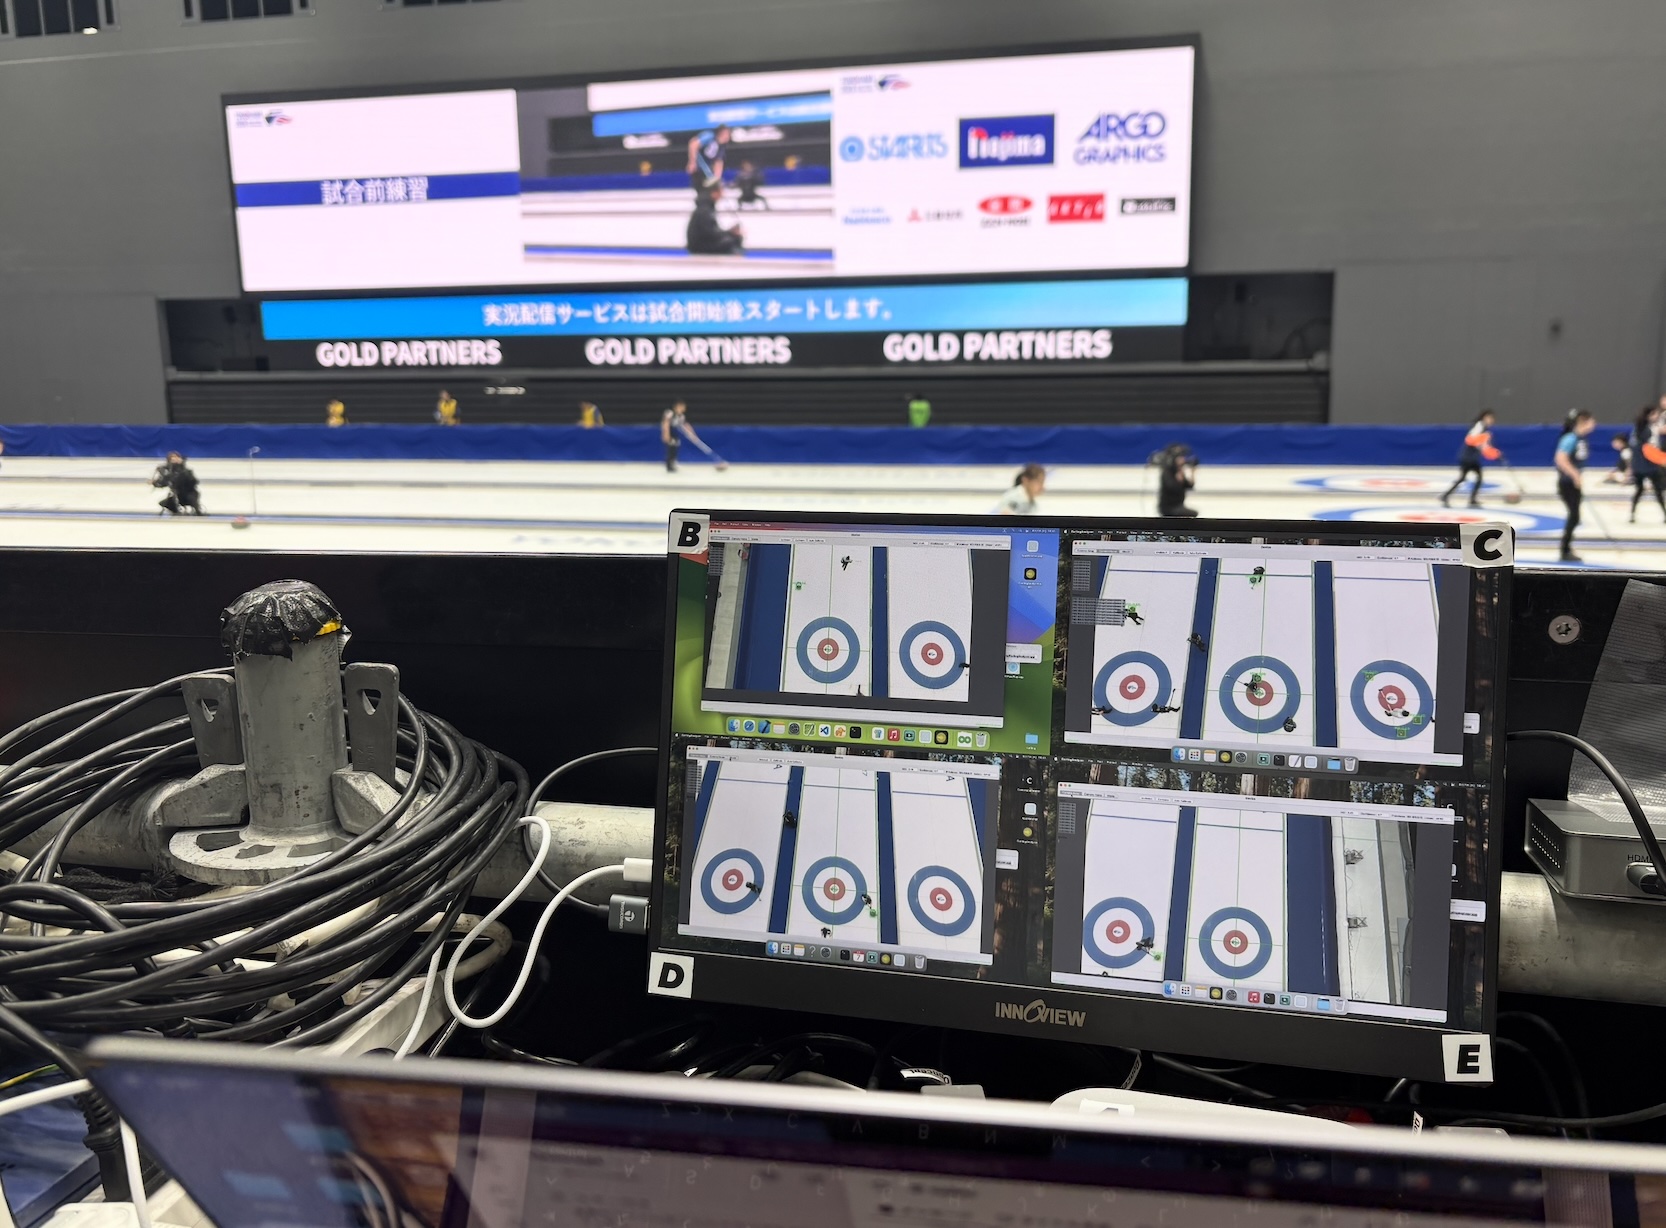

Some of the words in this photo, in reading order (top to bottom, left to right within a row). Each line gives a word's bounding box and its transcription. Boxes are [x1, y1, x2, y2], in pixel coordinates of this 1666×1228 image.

[1078, 111, 1167, 143] ARGO
[1073, 143, 1166, 166] GRAPHICS
[320, 176, 429, 206] 試合前練習
[316, 341, 379, 367] GOLD
[380, 339, 502, 366] PARTNERS
[585, 337, 655, 365] GOLD
[657, 336, 792, 364] PARTNERS
[882, 333, 961, 362] GOLD
[962, 329, 1113, 360] PARTNERS
[677, 521, 702, 547] B
[1473, 529, 1504, 561] C
[1627, 854, 1650, 862] HDM
[657, 961, 685, 989] D
[995, 999, 1086, 1028] INNOVIEW
[1457, 1044, 1481, 1074] E
